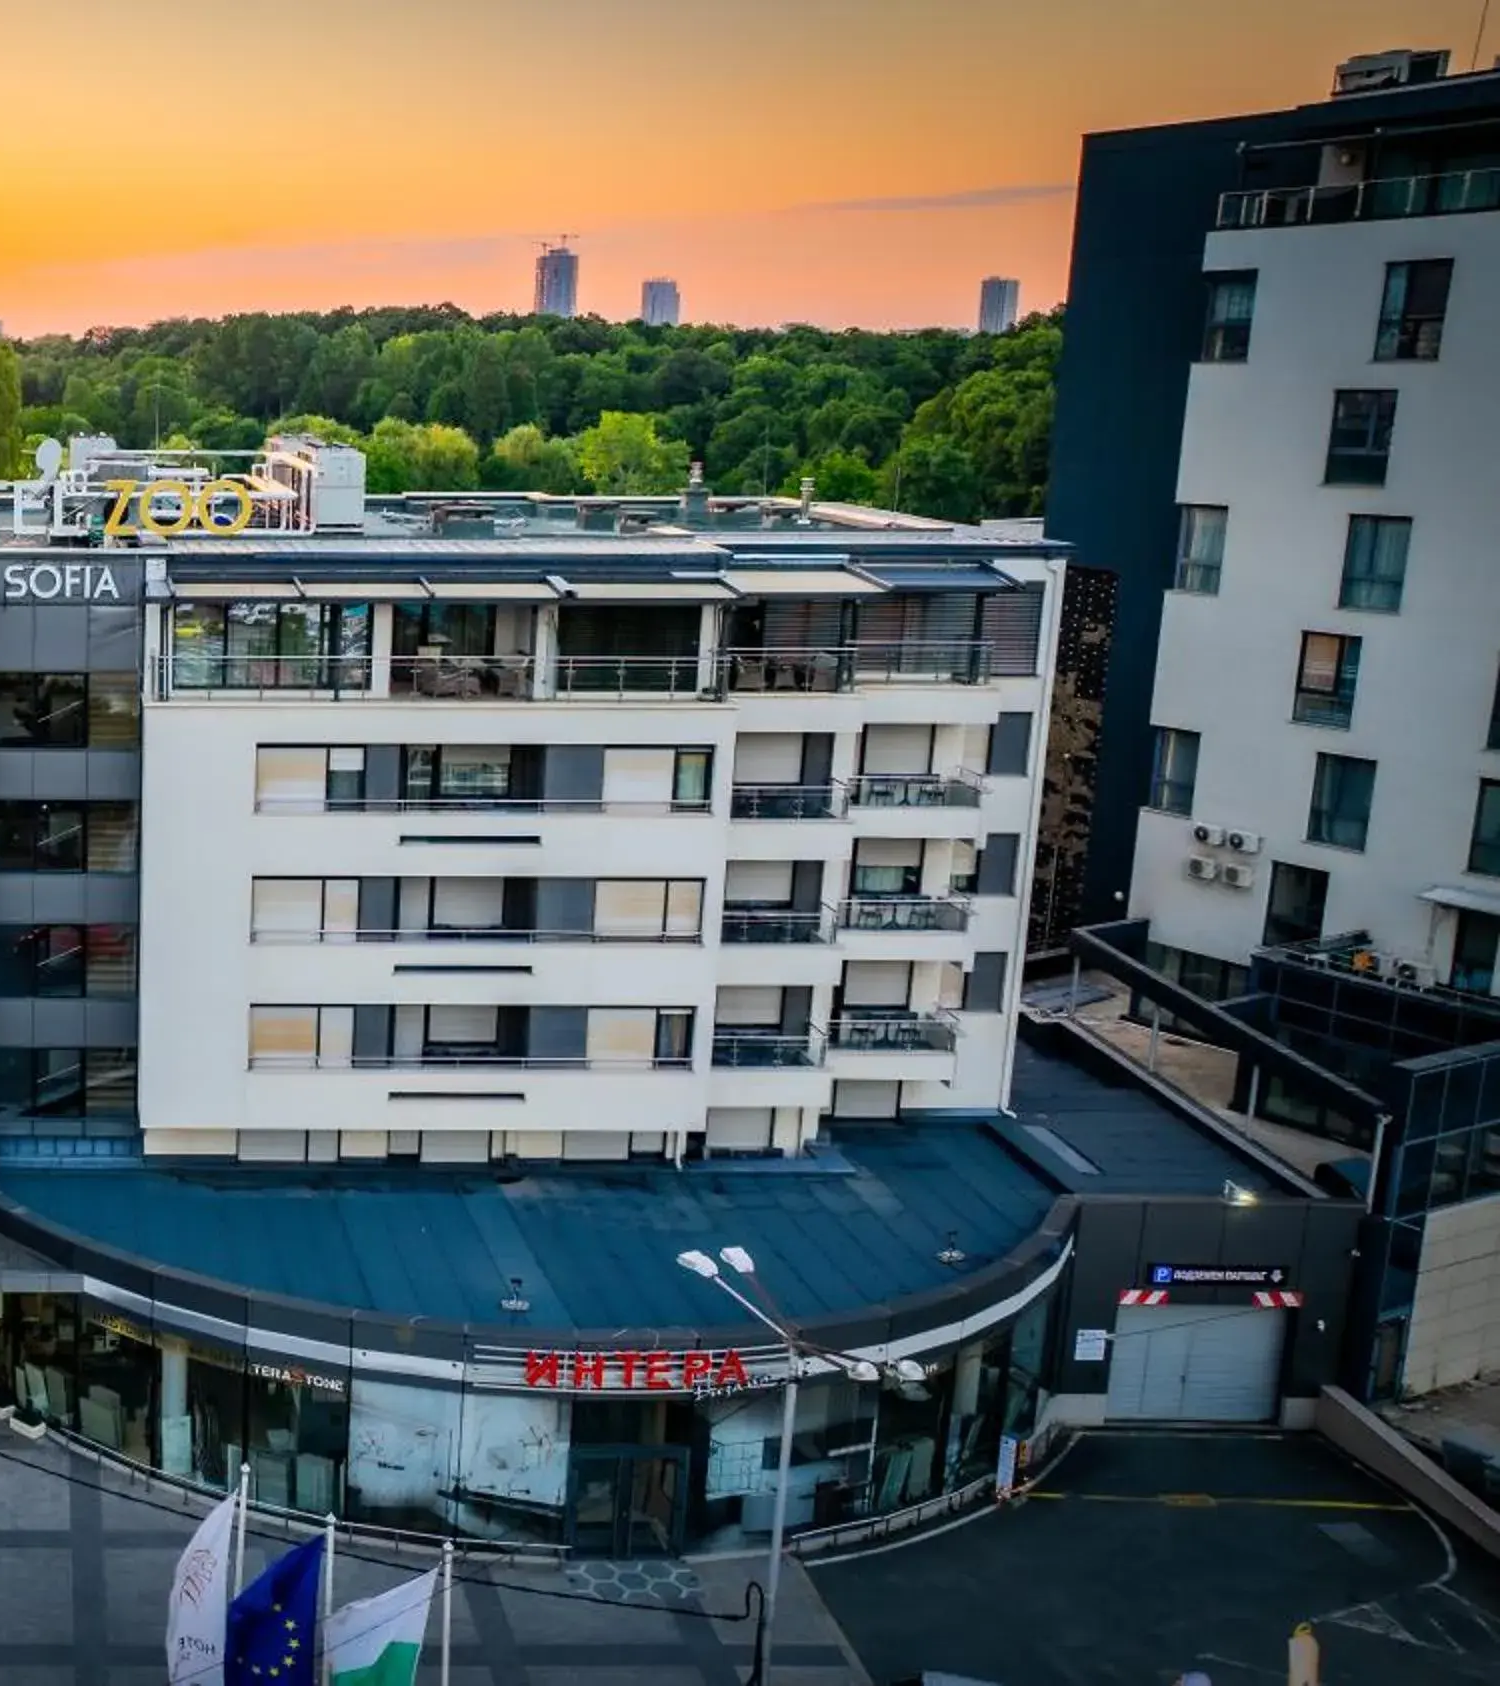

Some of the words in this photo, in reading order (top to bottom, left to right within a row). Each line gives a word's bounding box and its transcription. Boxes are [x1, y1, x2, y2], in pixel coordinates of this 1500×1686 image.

[104, 479, 253, 536] ZOO
[3, 564, 120, 599] SOFIA
[524, 1349, 749, 1389] ИНТЕРА
